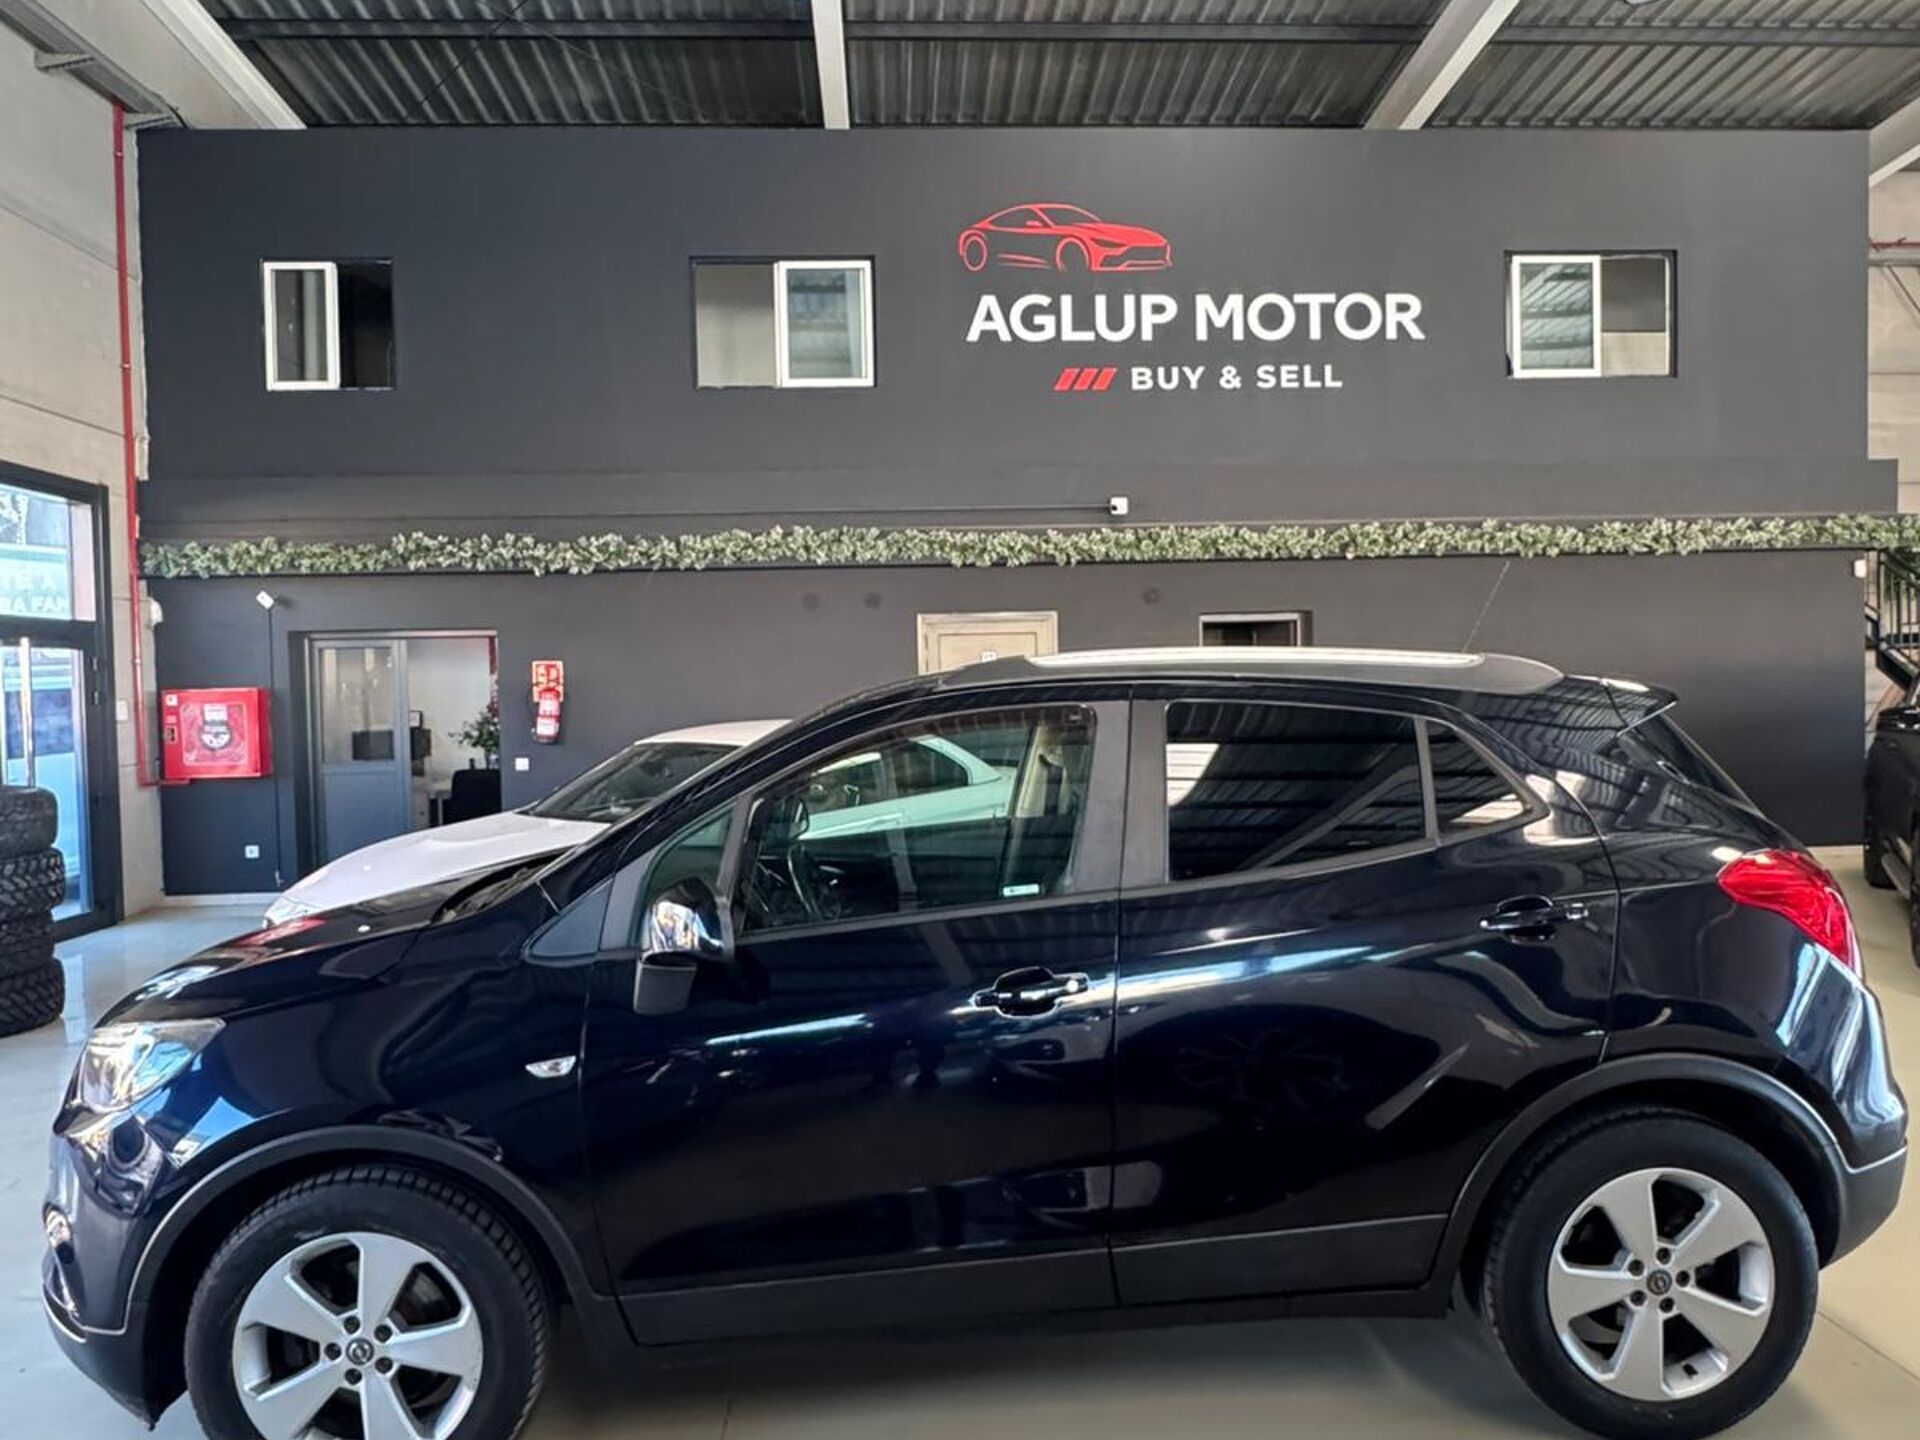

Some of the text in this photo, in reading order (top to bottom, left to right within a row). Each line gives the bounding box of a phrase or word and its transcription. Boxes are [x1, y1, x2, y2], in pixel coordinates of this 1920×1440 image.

[965, 292, 1426, 343] AGLUP MOTOR
[1130, 363, 1344, 391] BUY & SELL
